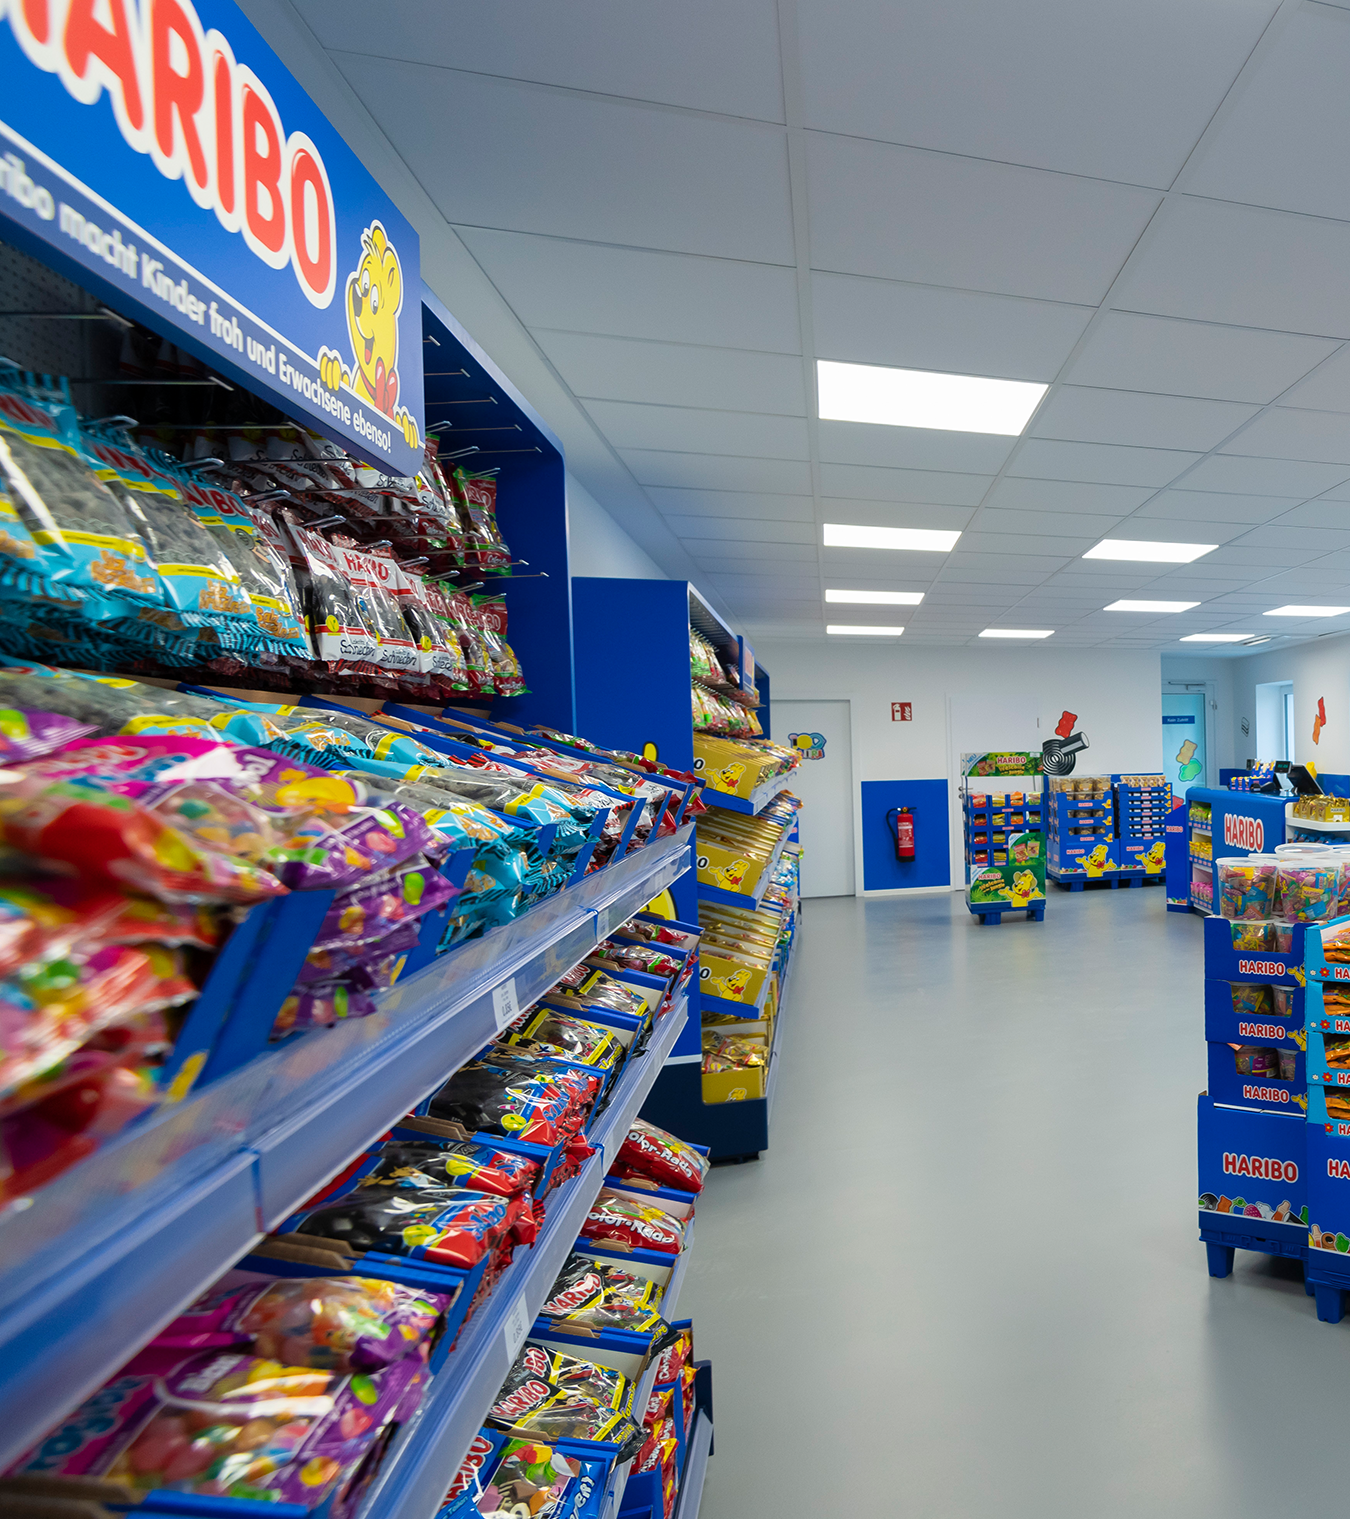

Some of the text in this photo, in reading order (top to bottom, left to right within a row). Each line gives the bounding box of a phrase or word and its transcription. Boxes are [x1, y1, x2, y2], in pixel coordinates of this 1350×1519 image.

[0, 0, 334, 302] ARIBO
[59, 202, 139, 279] macht
[141, 252, 207, 326] Kinder
[208, 301, 244, 353] froh
[246, 336, 276, 375] und
[279, 352, 351, 425] Erwachsene
[352, 409, 392, 454] ebenso!
[997, 756, 1026, 764] HARIBO
[1225, 813, 1264, 853] HARIBO
[1239, 960, 1285, 976] HARIBO
[1240, 1022, 1286, 1039] HARIBO
[1243, 1085, 1289, 1103] HARIBO
[628, 1131, 692, 1178] olor-Rado
[1223, 1153, 1298, 1184] HARIBO
[588, 1211, 675, 1243] olor-Rado
